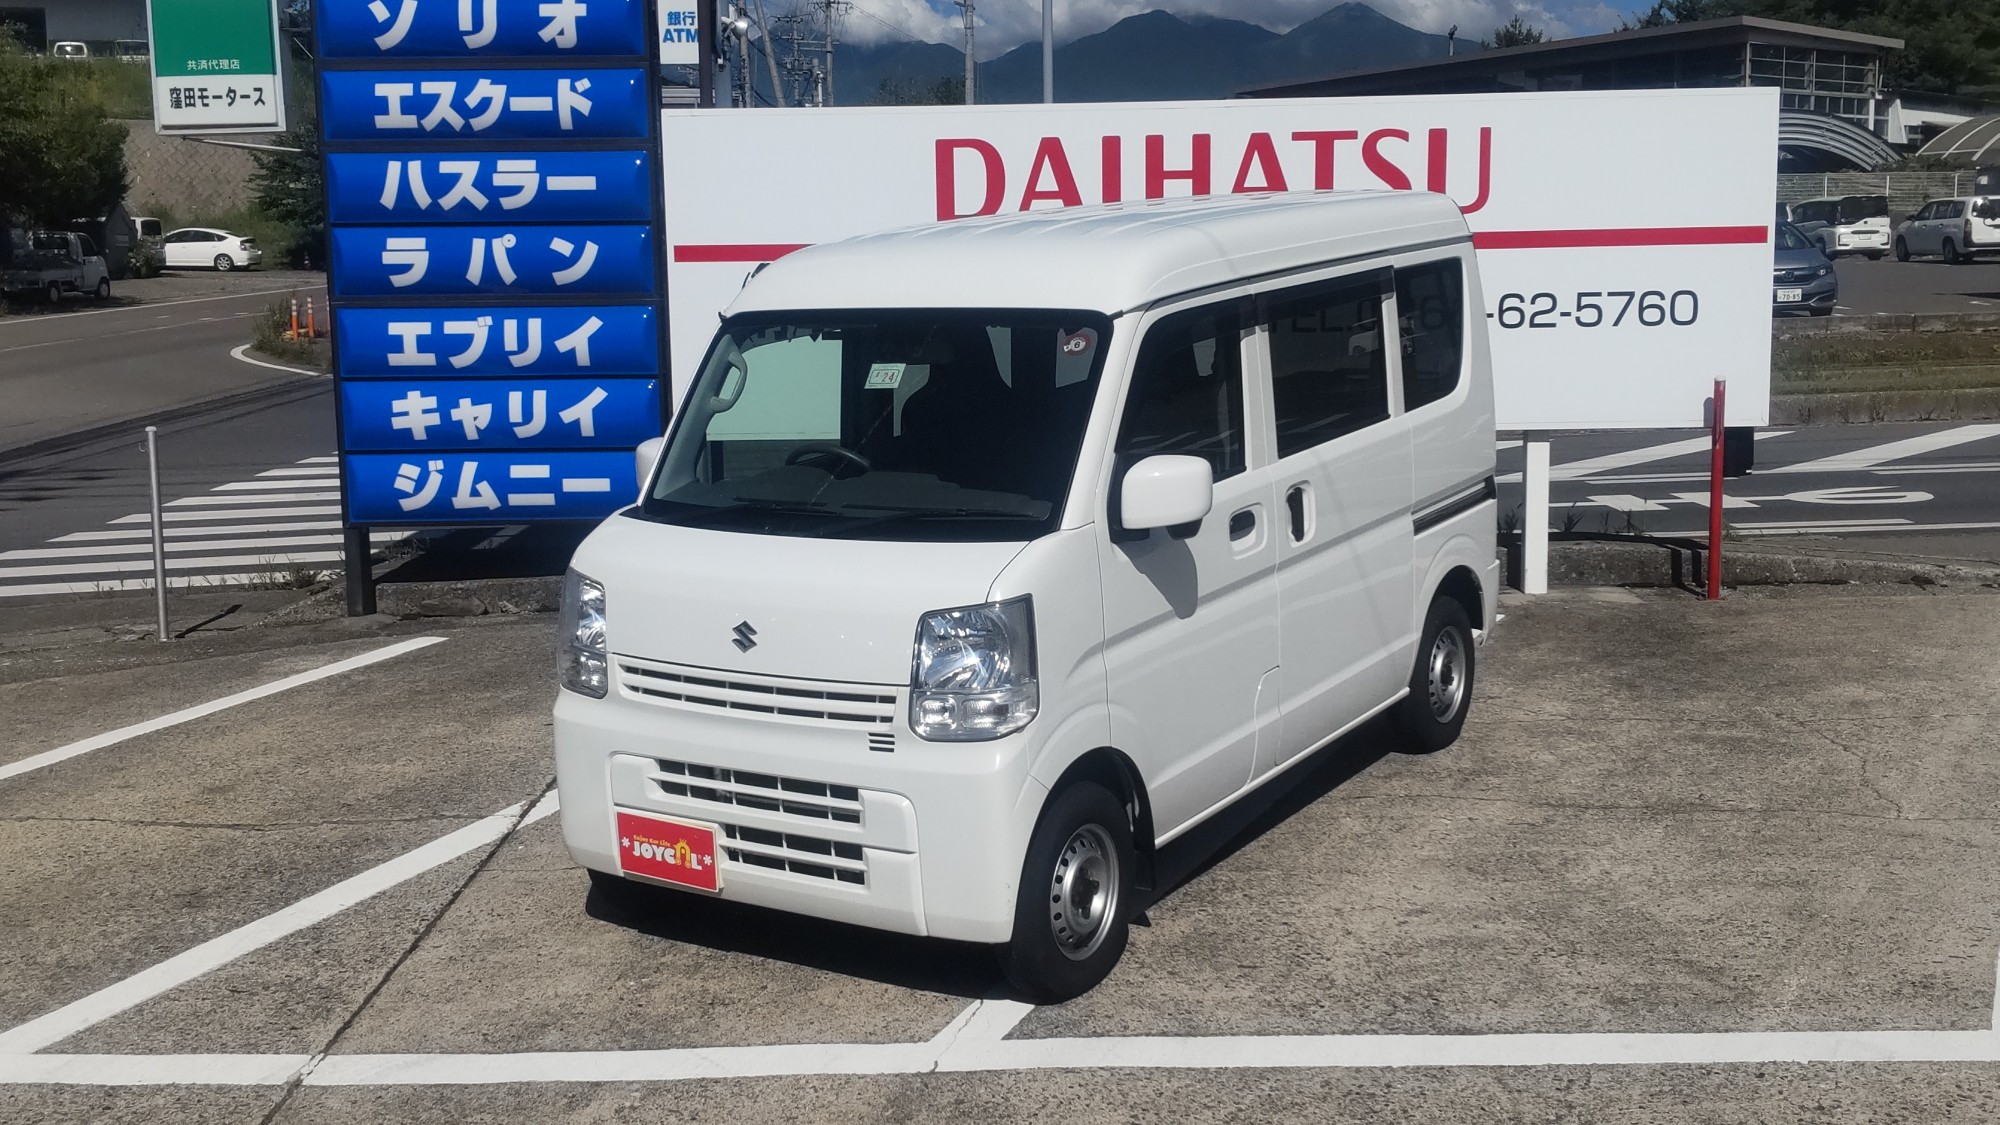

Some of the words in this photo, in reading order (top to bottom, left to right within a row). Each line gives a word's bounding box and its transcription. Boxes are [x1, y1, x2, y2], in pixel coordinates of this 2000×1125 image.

[367, 0, 588, 50] ソリオ
[663, 28, 699, 43] ATM
[667, 11, 697, 26] 銀行
[186, 59, 240, 70] 共済代理店
[169, 86, 266, 109] 窪田モータース
[373, 77, 593, 131] エスクード
[379, 159, 597, 211] ハスラー
[935, 127, 1491, 221] DAIHATSU
[381, 233, 599, 288] ラパン
[386, 315, 604, 369] エブリイ
[390, 386, 609, 440] キャリイ
[393, 459, 611, 512] ジムニー
[632, 839, 703, 871] JOYCAL
